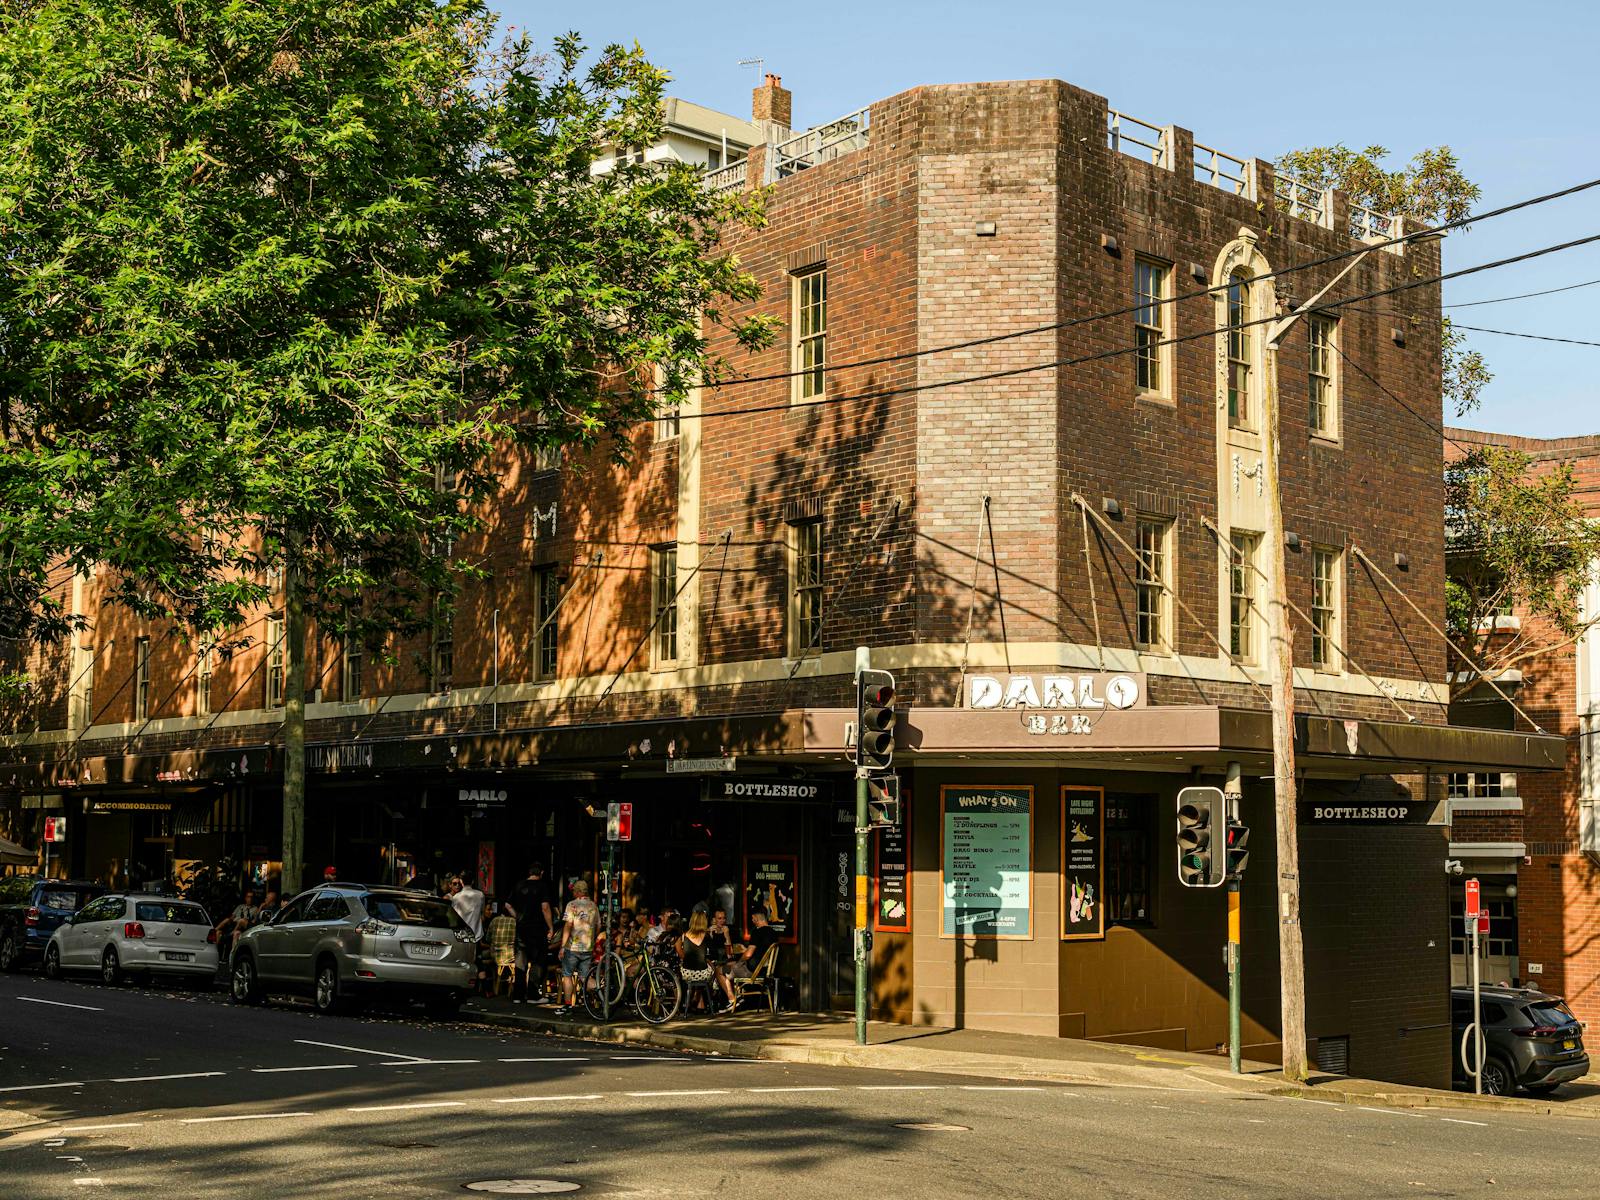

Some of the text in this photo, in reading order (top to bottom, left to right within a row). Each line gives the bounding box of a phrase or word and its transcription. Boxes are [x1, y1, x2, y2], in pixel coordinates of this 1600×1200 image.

[970, 675, 1140, 710] DARLO
[1027, 714, 1093, 735] BAR
[458, 789, 508, 801] DARLO
[724, 782, 818, 798] BOTTLESHOP
[94, 802, 172, 811] ACCOMMODATION
[958, 795, 1018, 807] WHAT'S ON
[1314, 807, 1408, 819] BOTTLESHOP
